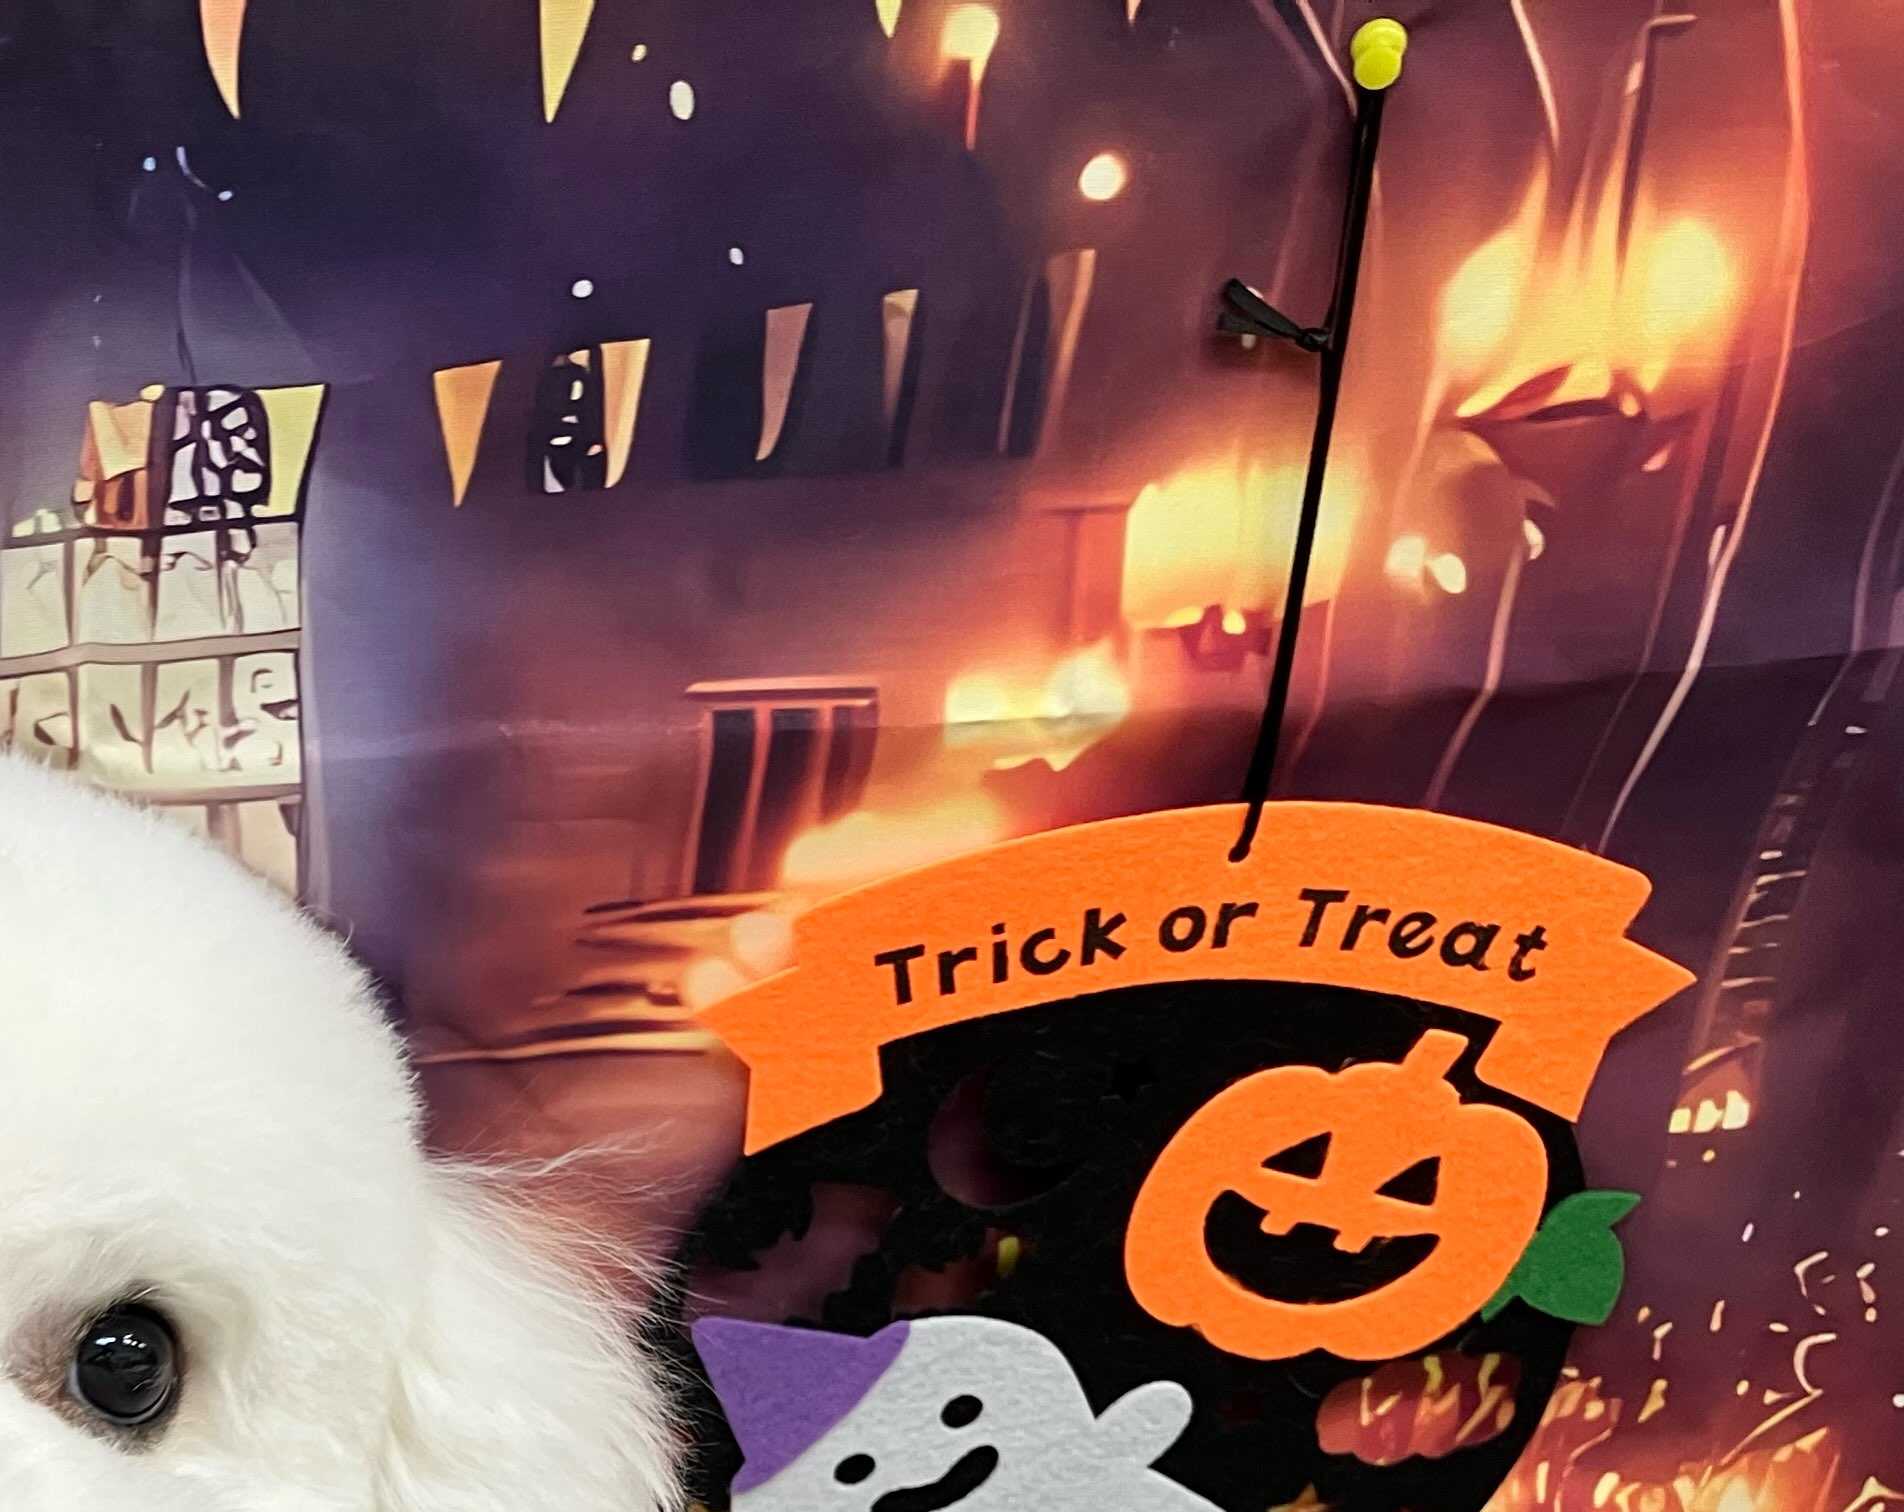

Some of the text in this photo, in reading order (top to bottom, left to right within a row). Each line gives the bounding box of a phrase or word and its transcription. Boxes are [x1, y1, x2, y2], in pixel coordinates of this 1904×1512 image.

[875, 888, 1548, 1006] Trick or Treat
